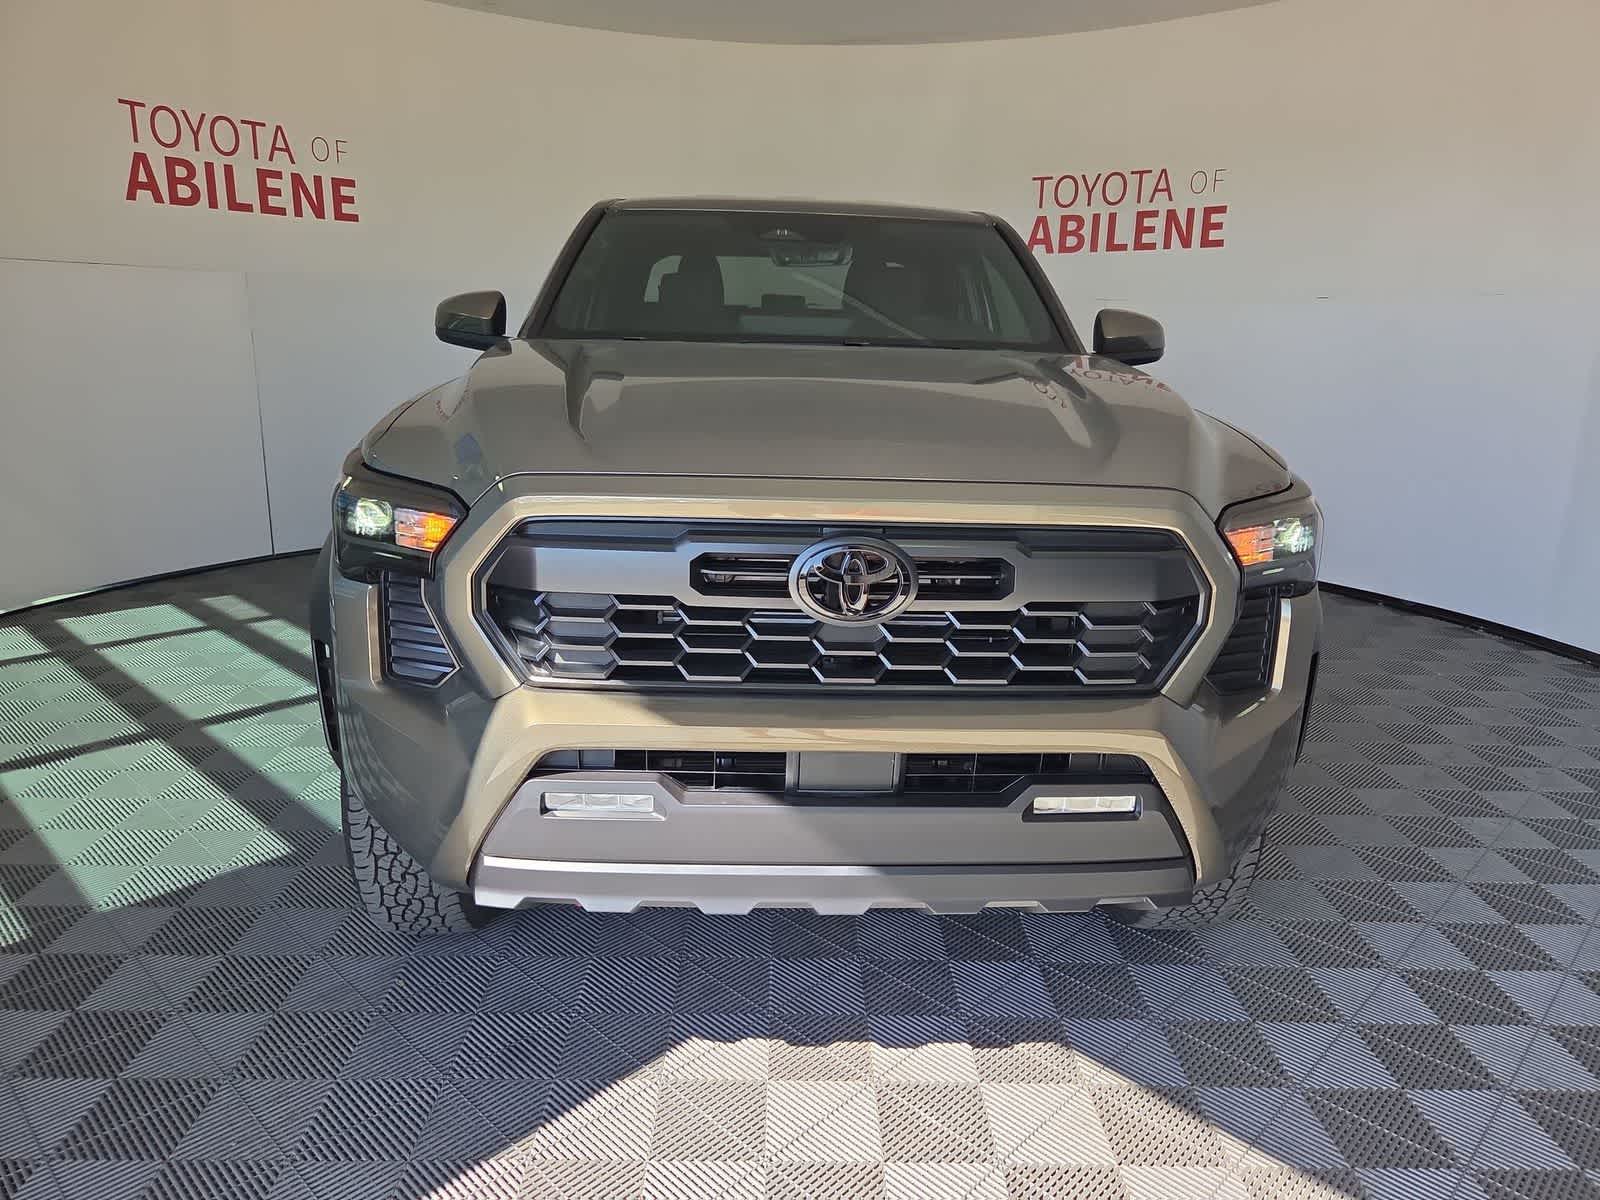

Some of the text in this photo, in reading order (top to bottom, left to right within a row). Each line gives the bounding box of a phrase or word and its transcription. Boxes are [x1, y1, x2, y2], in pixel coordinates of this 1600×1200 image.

[118, 98, 348, 165] TOYOTA OF
[126, 151, 359, 222] ABILENE
[1032, 168, 1227, 209] TOYOTA OF
[1027, 205, 1228, 254] ABILENE
